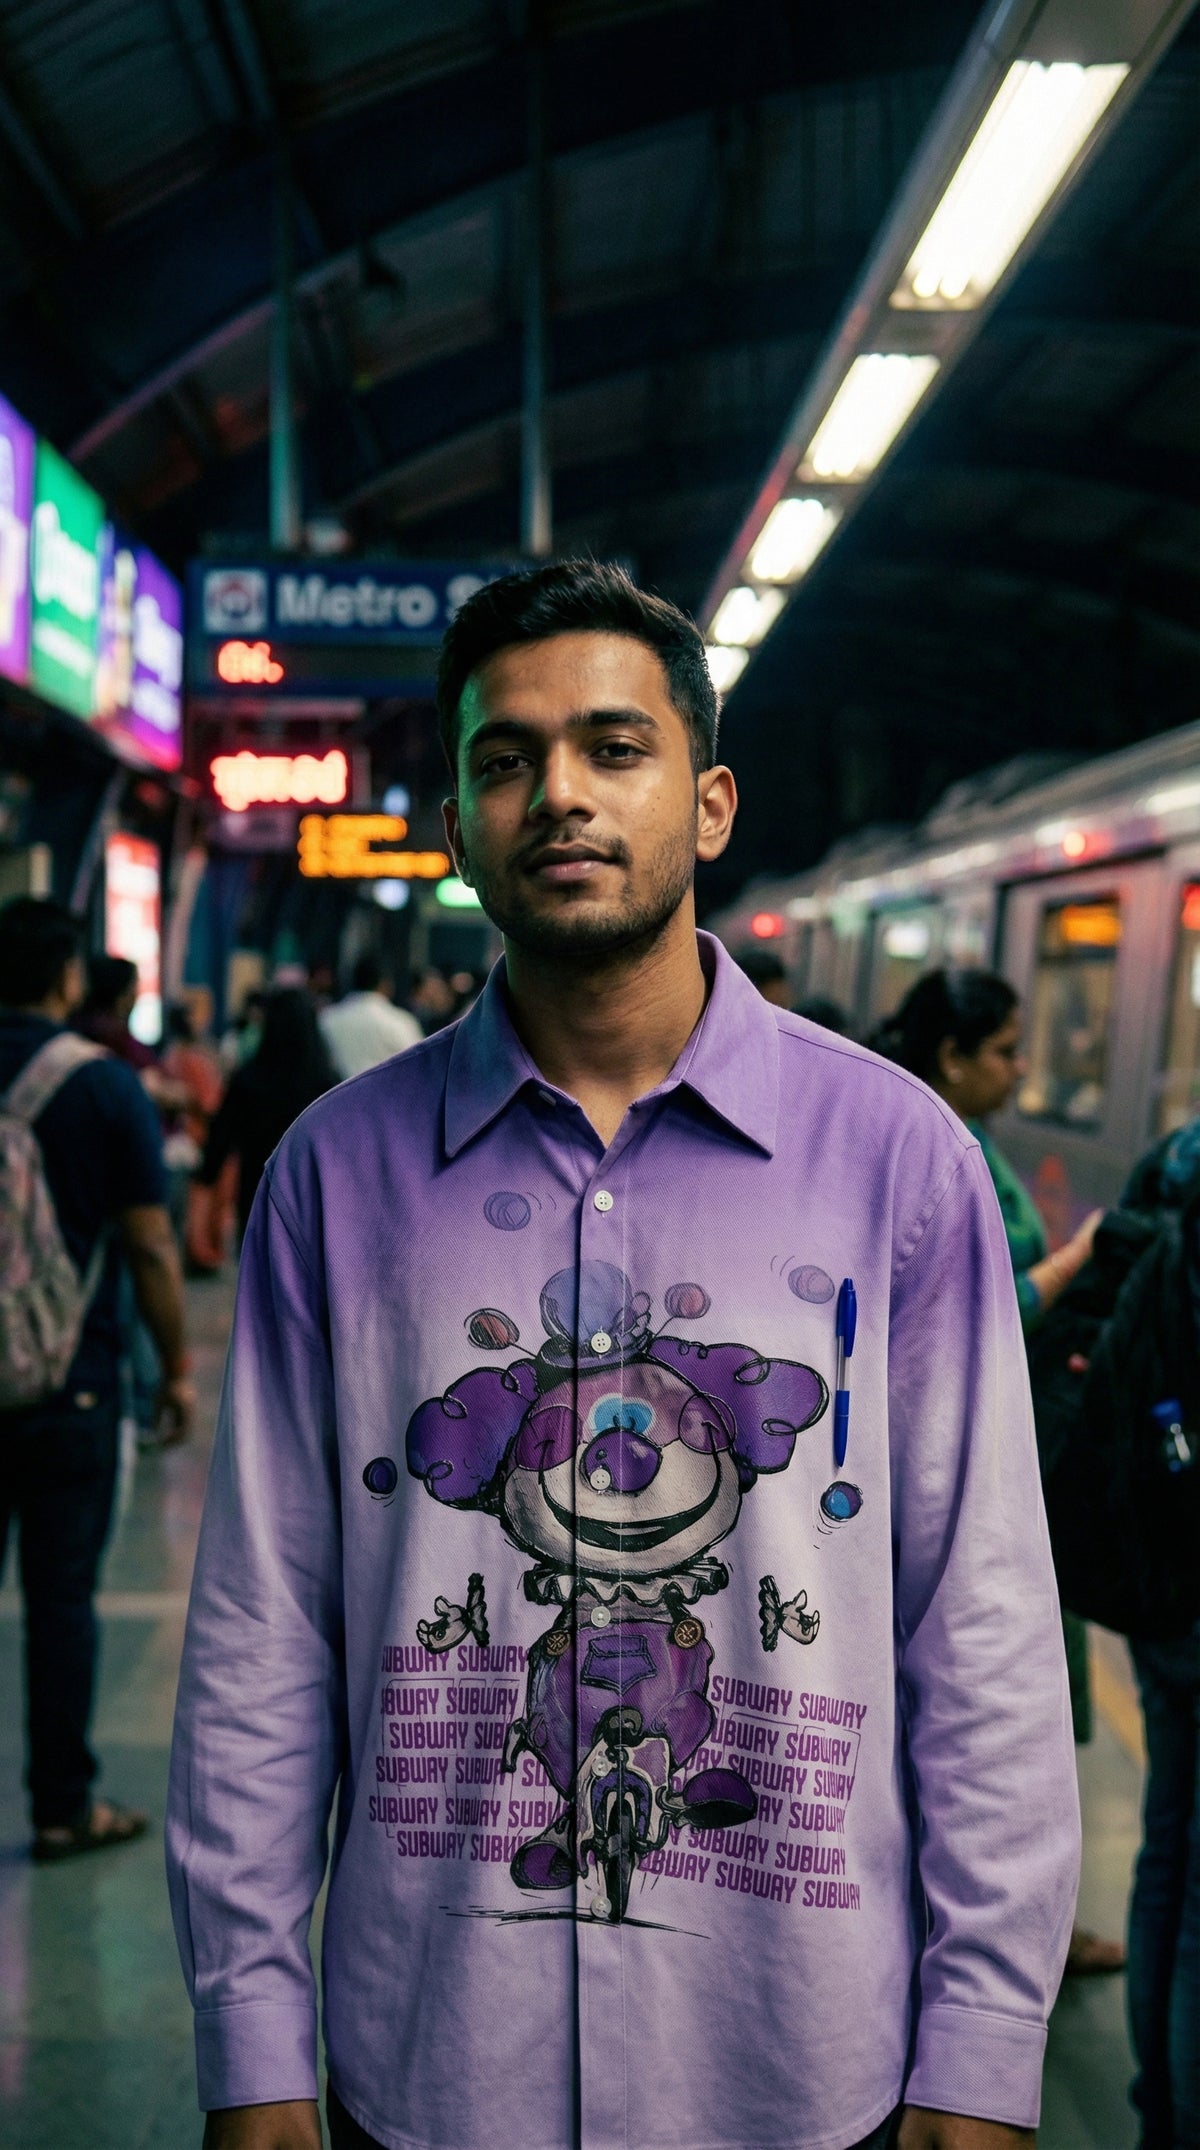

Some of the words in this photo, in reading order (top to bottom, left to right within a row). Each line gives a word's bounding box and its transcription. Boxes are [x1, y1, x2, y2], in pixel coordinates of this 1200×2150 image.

[276, 574, 438, 627] Metro
[382, 1645, 449, 1672] UBWAY
[457, 1645, 528, 1672] SUBWAY
[381, 1687, 439, 1715] BWAY
[446, 1687, 518, 1715] SUBWAY
[711, 1675, 792, 1716] SUBWAY
[799, 1692, 867, 1729] SUBWAY
[390, 1721, 468, 1749] SUBWAY
[474, 1721, 505, 1749] SUB
[710, 1717, 779, 1756] UBWAY
[784, 1733, 851, 1767] SUBWAY
[376, 1756, 448, 1783] SUBWAY
[455, 1757, 505, 1785] SUBWA
[813, 1769, 855, 1800] SUBWAY
[369, 1796, 438, 1824] SUBWAY
[446, 1797, 500, 1828] SUBWAY
[788, 1802, 845, 1834] SUBWAY
[397, 1830, 466, 1859] SUBWAY
[775, 1841, 846, 1875] SUBWAY
[715, 1861, 797, 1904] SUBWAY
[803, 1880, 861, 1911] SUBWAY
